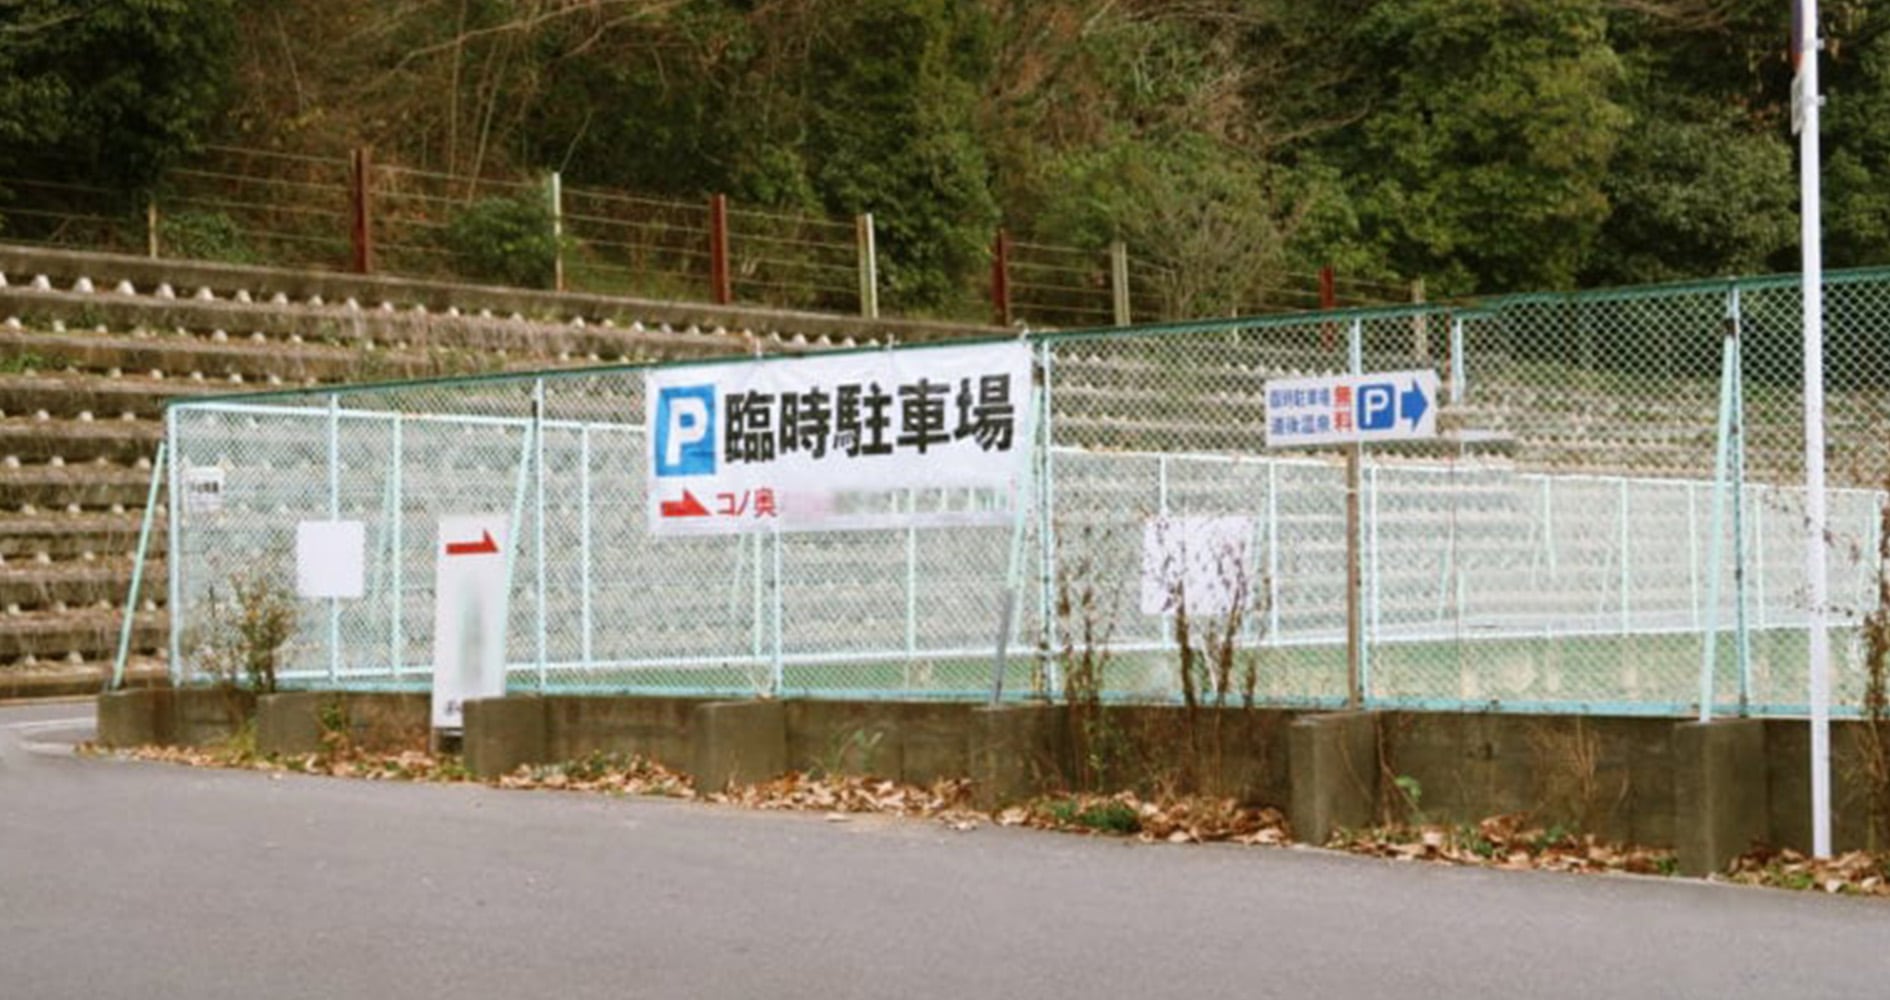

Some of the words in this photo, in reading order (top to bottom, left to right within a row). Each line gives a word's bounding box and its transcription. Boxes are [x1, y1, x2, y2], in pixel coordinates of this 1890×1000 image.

[664, 397, 708, 467] P
[723, 373, 1014, 464] 臨時駐車場
[1334, 385, 1352, 432] 無料
[1365, 388, 1390, 426] P
